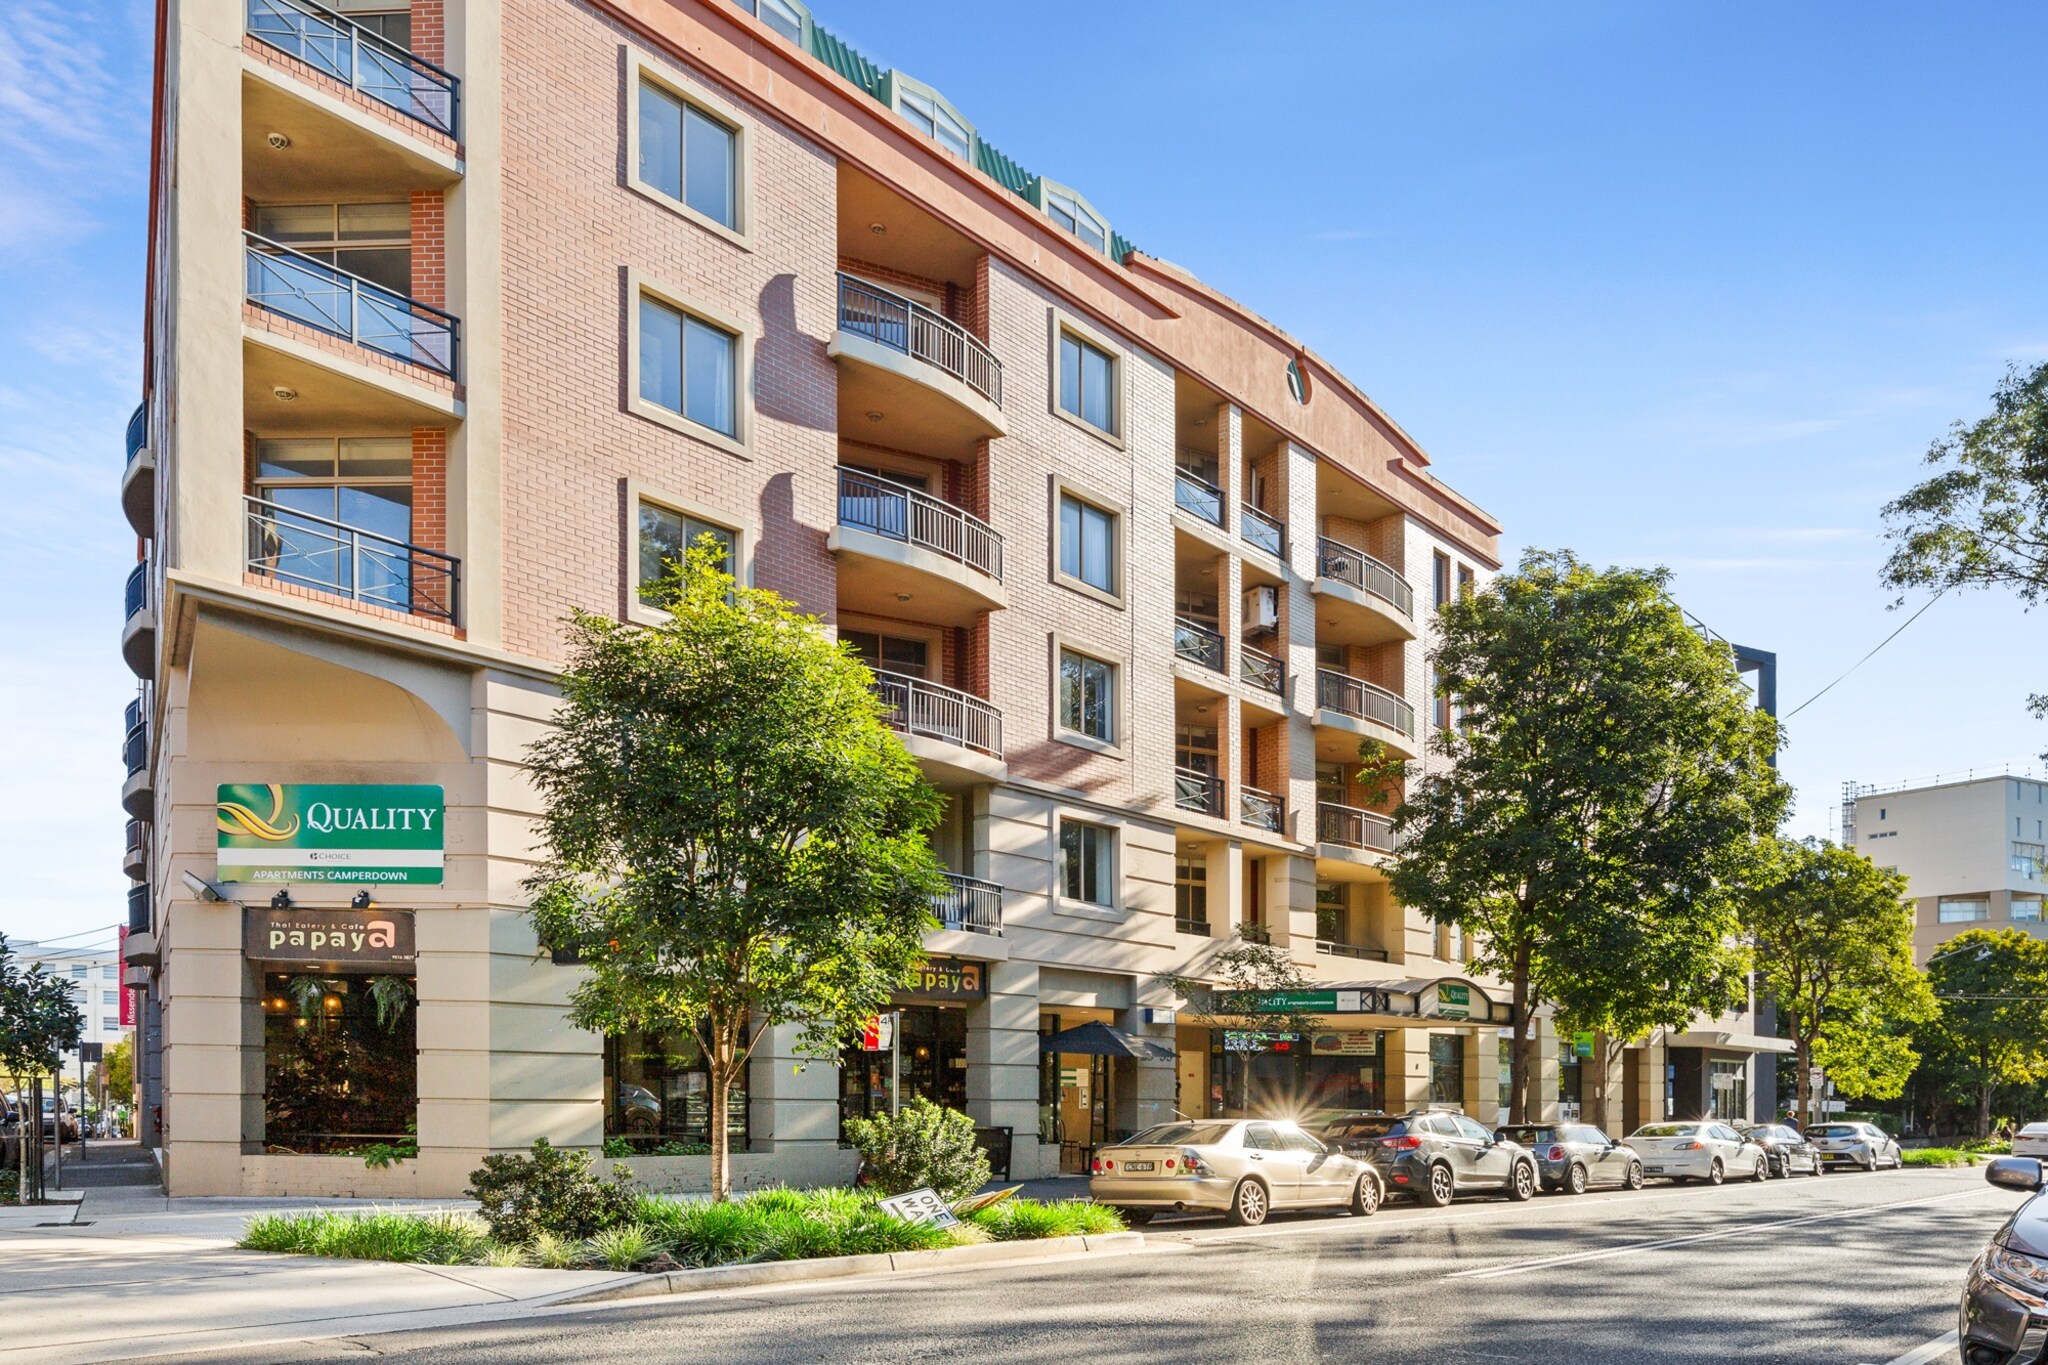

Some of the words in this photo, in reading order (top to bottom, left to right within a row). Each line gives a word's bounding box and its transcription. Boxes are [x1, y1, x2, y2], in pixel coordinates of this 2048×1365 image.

[307, 802, 437, 833] QUALITY
[253, 870, 324, 880] APARTMENTS
[327, 870, 408, 881] CAMPERDOWN
[269, 920, 396, 952] papaya
[295, 922, 326, 930] Eatery
[907, 965, 979, 993] apaya
[902, 1197, 926, 1220] WA
[920, 1195, 950, 1222] ONE
